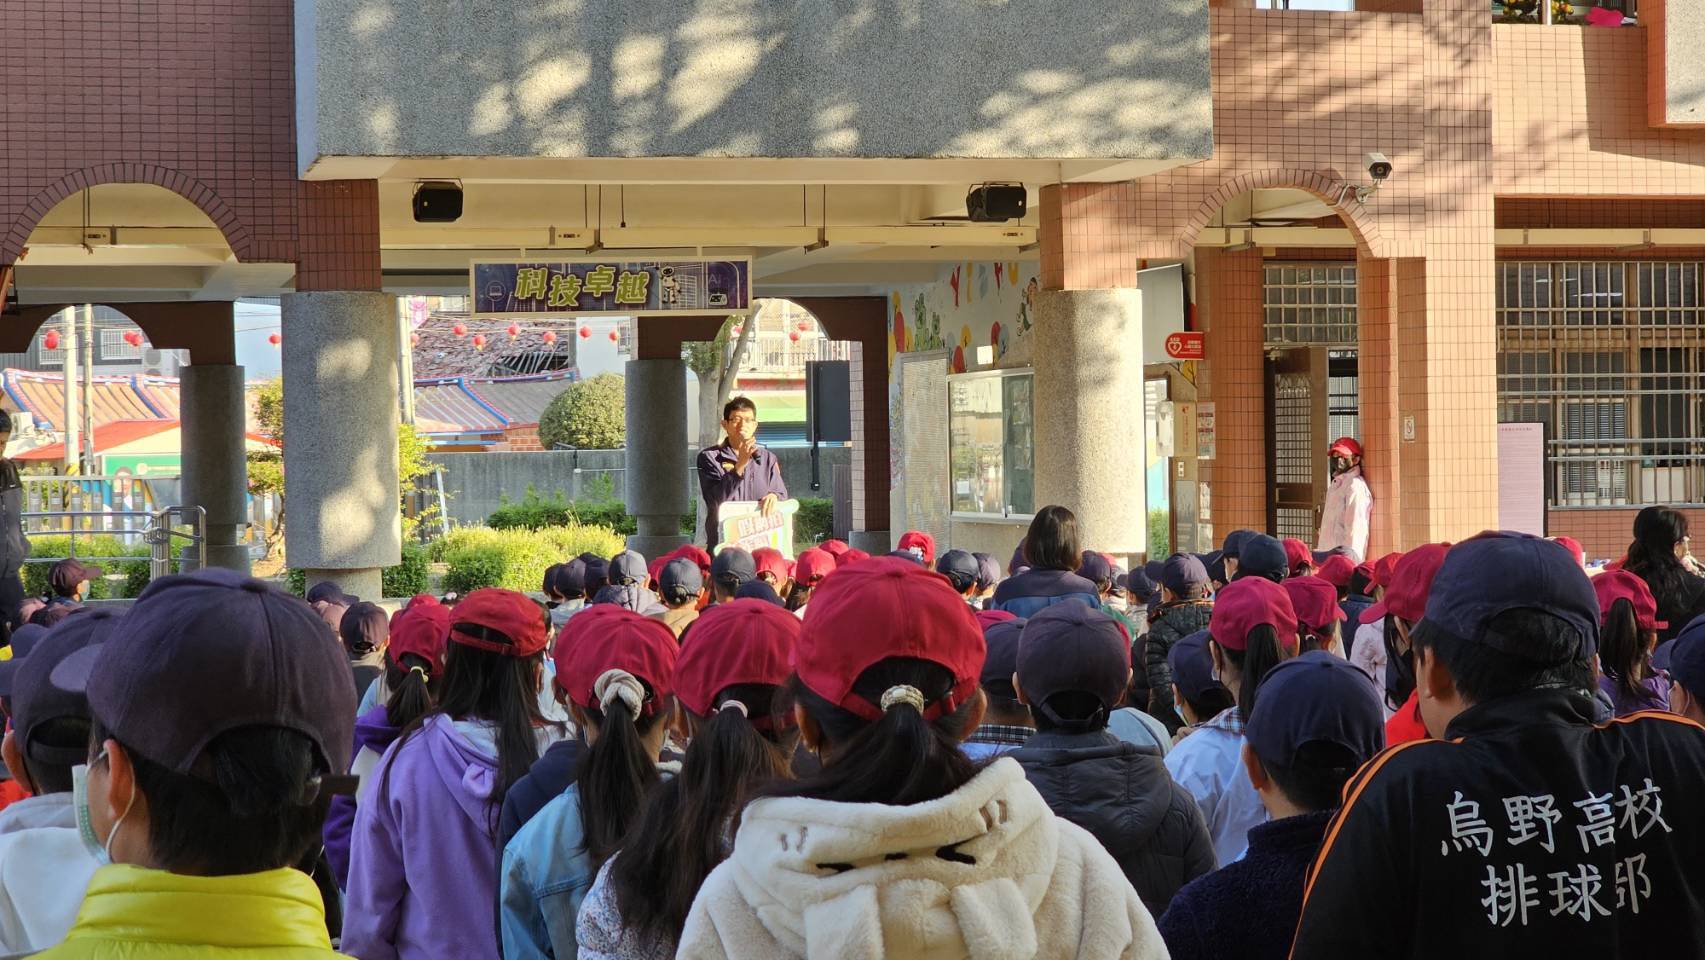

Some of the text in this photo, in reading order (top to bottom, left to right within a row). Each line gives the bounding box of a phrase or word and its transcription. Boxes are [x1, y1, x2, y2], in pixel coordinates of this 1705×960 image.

[514, 264, 650, 307] 科技卓越
[1441, 777, 1673, 857] 烏野高校
